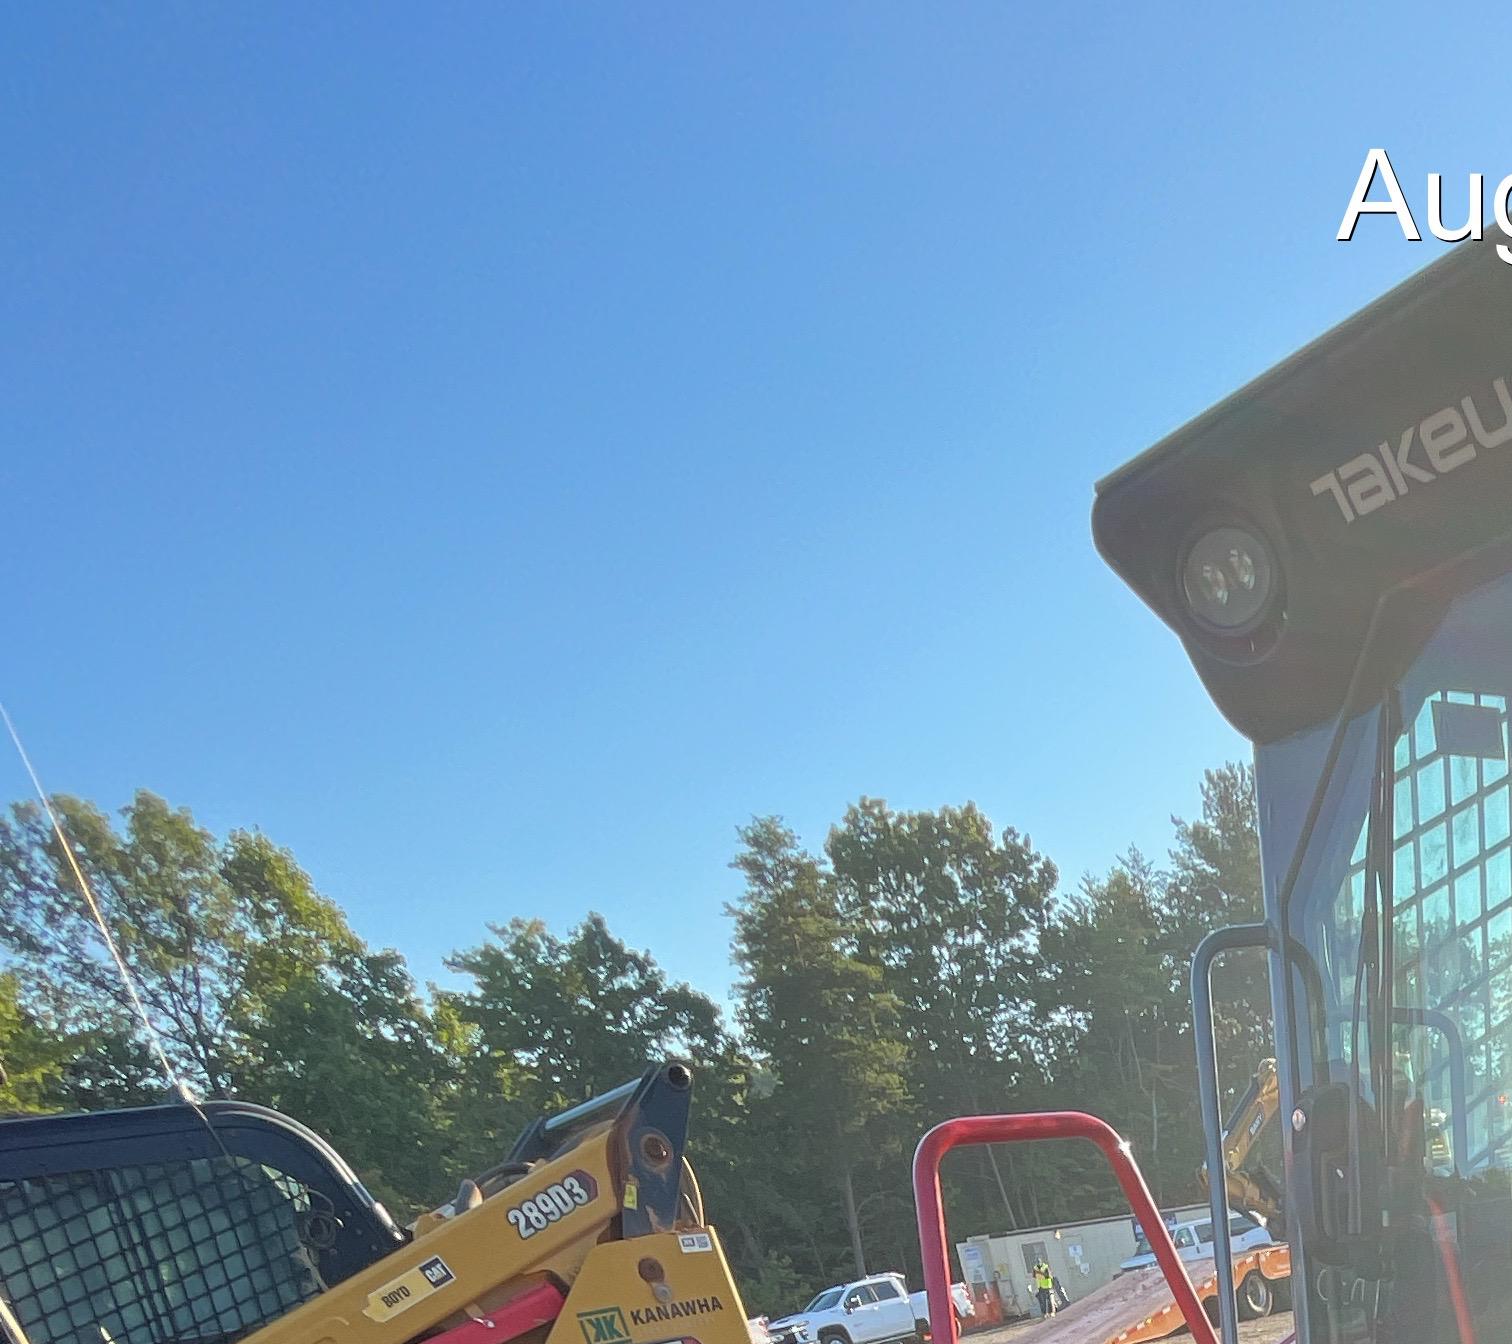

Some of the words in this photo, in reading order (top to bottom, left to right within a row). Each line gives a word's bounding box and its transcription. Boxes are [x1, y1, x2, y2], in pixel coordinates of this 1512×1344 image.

[507, 1176, 588, 1239] 289D3
[424, 1262, 449, 1283] CAT
[380, 1286, 410, 1308] BOYD
[630, 1296, 723, 1325] KANAWHA
